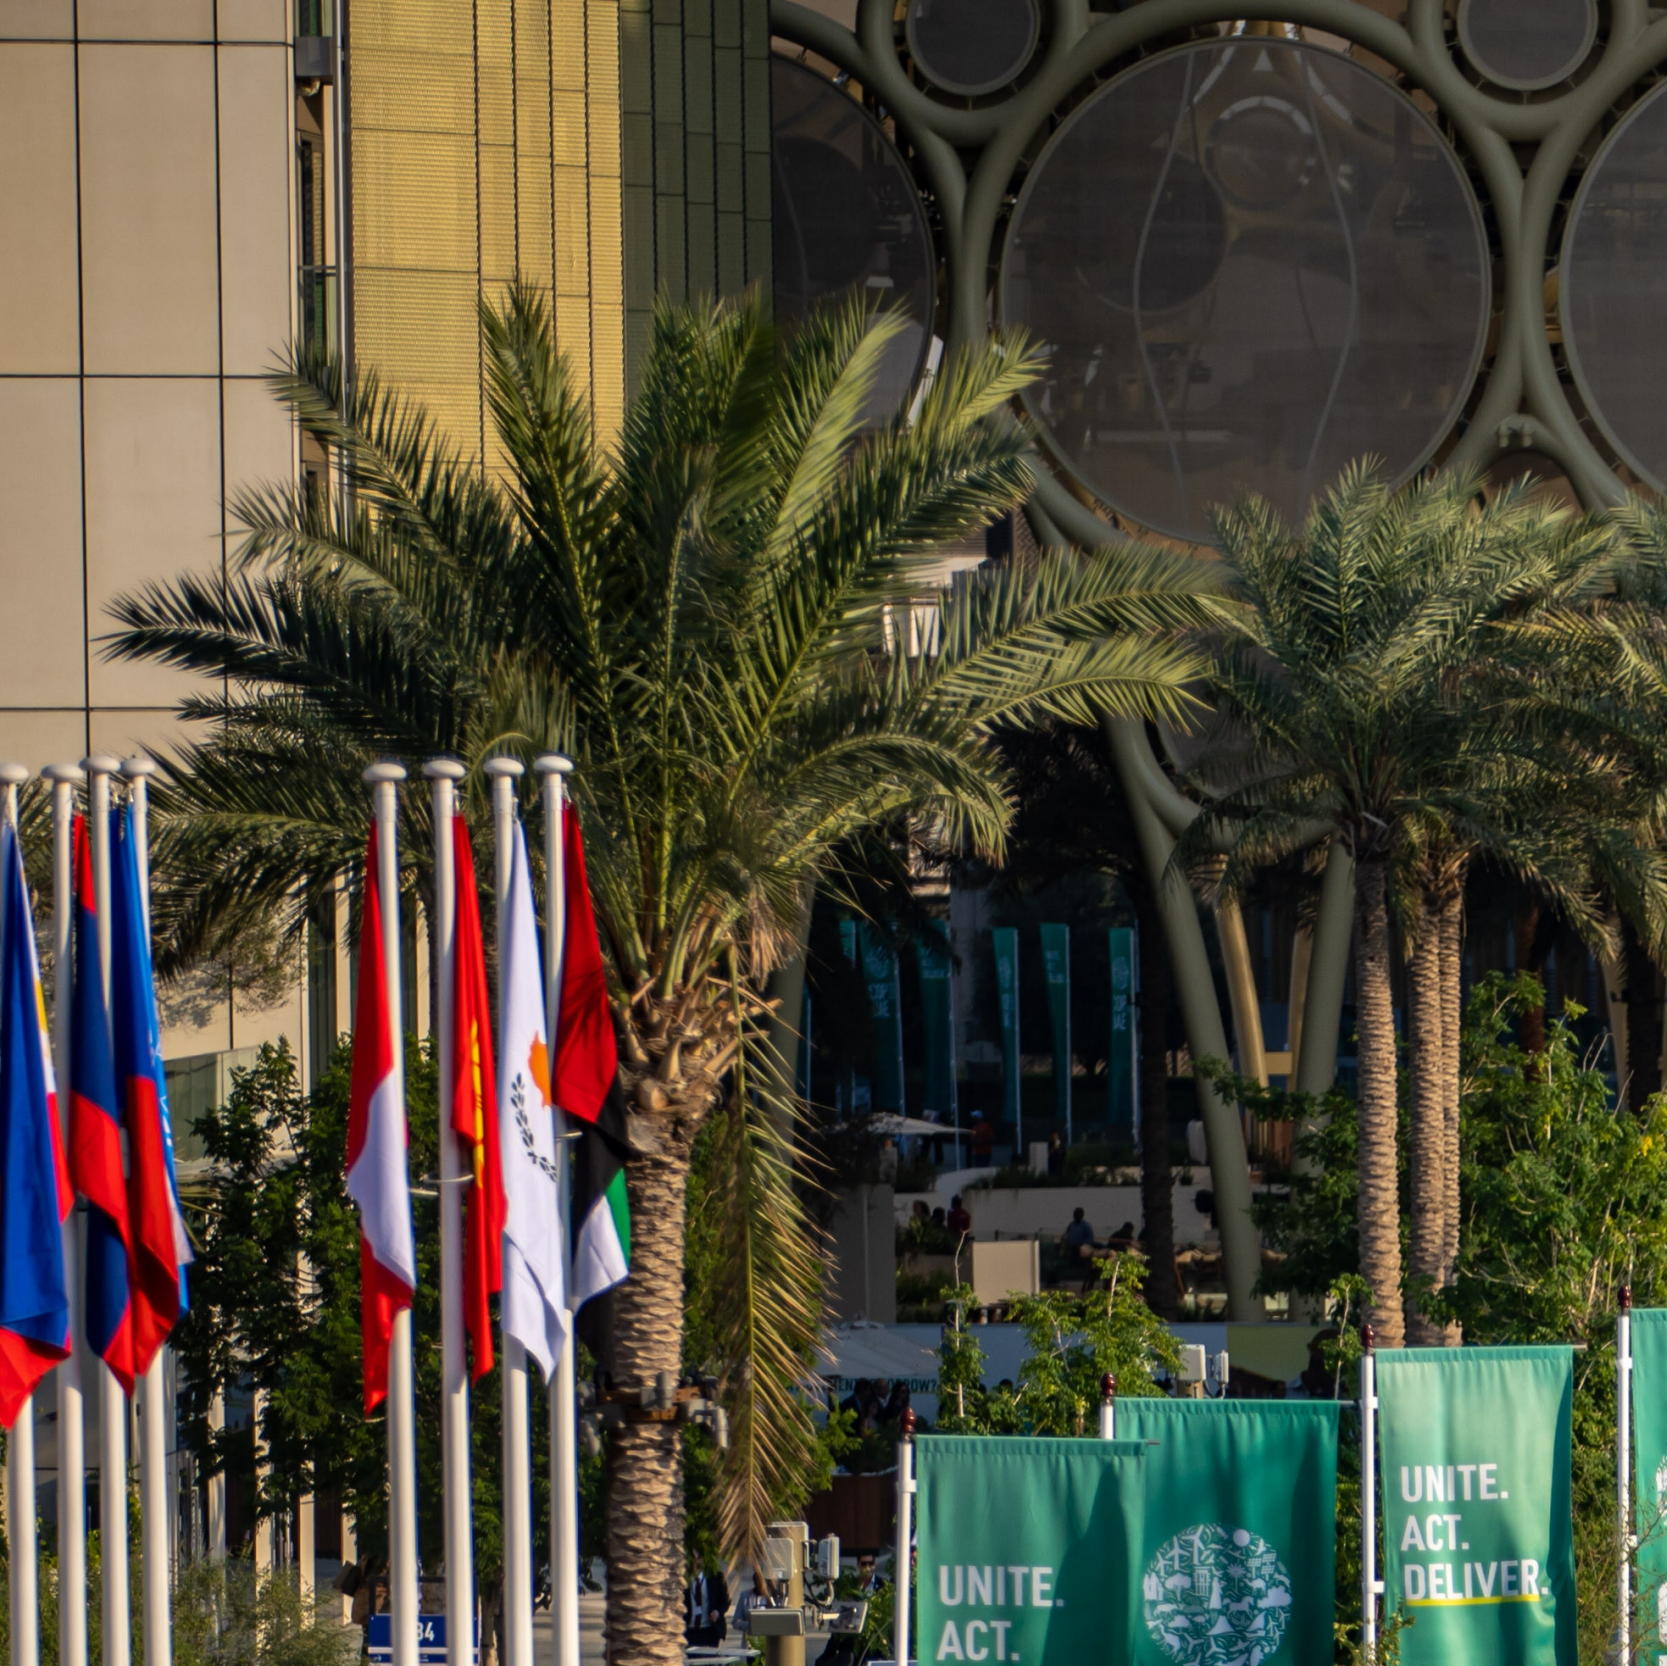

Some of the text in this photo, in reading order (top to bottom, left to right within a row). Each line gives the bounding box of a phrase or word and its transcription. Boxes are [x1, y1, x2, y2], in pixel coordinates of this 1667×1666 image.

[1400, 1463, 1509, 1503] UNITE.
[1400, 1513, 1469, 1552] ACT.
[938, 1564, 1065, 1608] UNITE.
[1402, 1558, 1549, 1602] DELIVER.
[936, 1620, 1020, 1662] ACT.
